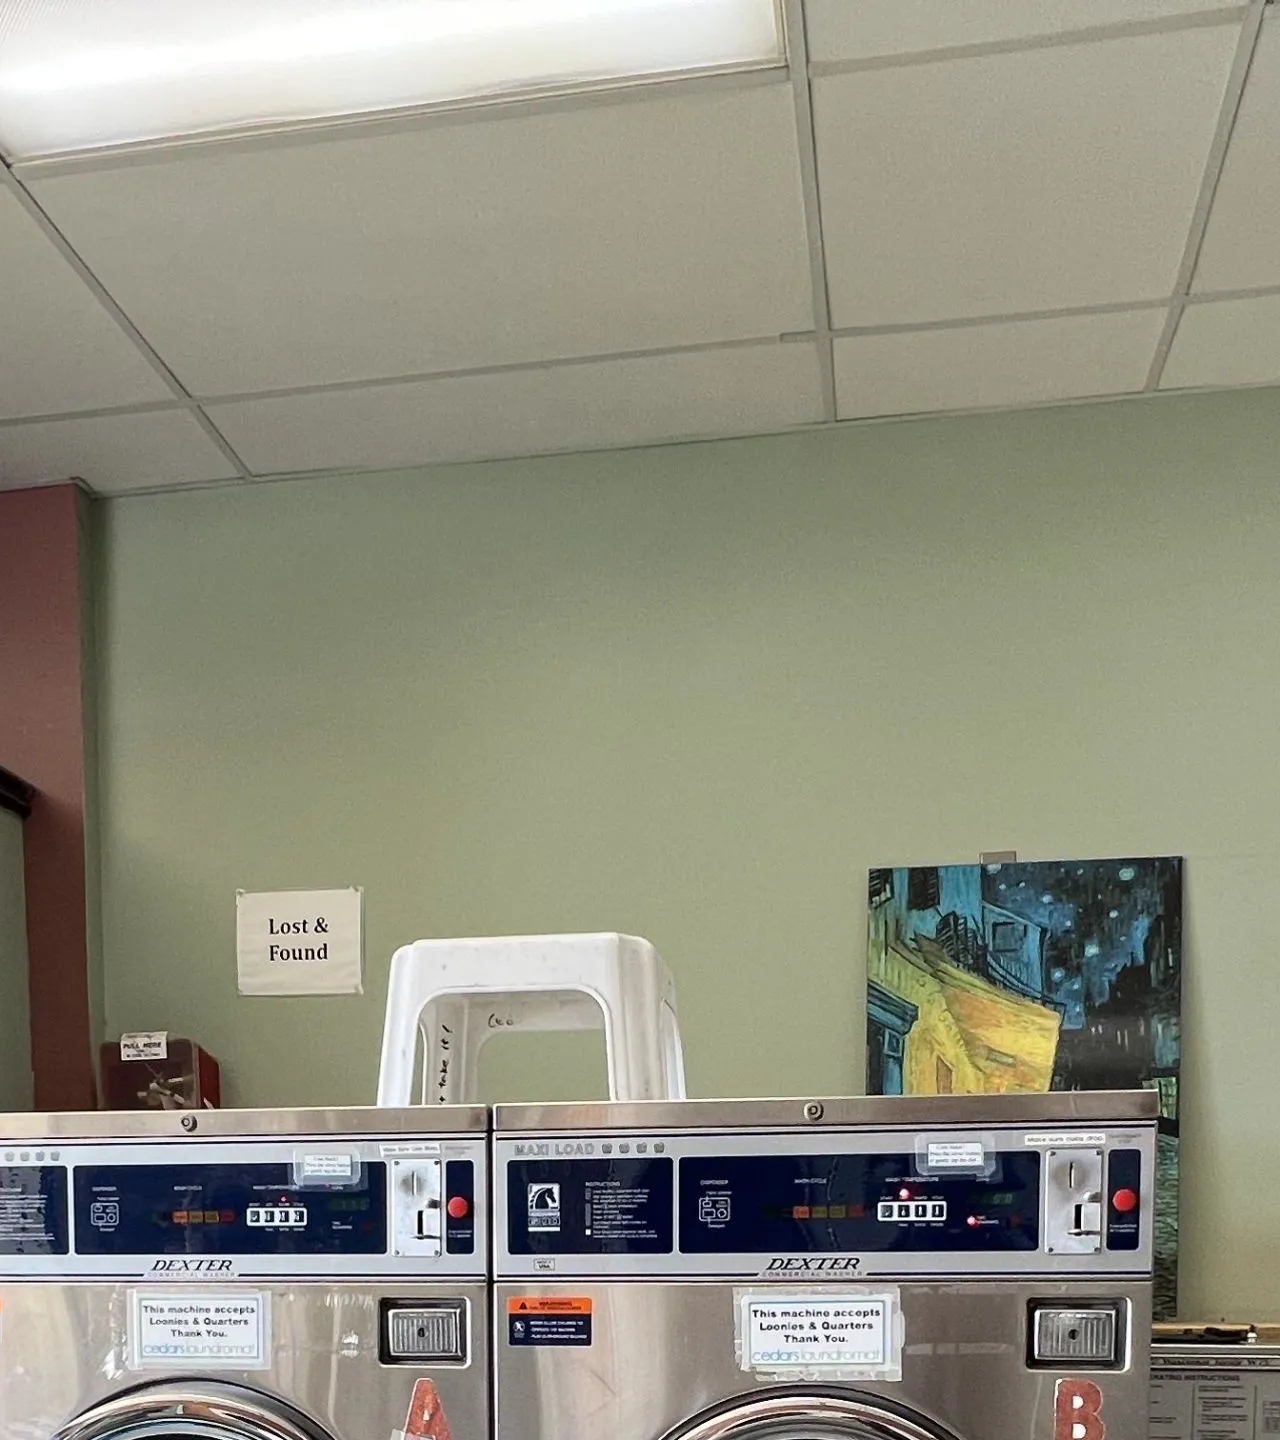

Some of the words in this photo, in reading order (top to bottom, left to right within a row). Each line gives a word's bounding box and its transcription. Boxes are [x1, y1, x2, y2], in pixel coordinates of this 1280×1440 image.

[268, 918, 308, 935] Lost
[313, 917, 329, 934] &
[269, 943, 329, 961] Found
[514, 1144, 549, 1155] MAXI
[555, 1143, 595, 1155] LOAD
[150, 1259, 233, 1271] DEXTER
[765, 1257, 861, 1270] DEXTER
[143, 1305, 165, 1314] This
[168, 1305, 211, 1314] machine
[214, 1305, 256, 1315] accepts
[752, 1309, 777, 1318] This
[781, 1308, 830, 1318] machine
[833, 1308, 881, 1320] accepts
[149, 1317, 189, 1326] Loonies
[192, 1317, 200, 1326] &
[203, 1317, 249, 1326] Quarters
[759, 1321, 805, 1331] Loonies
[808, 1321, 818, 1331] &
[821, 1321, 874, 1331] Quarters
[171, 1328, 203, 1337] Thank
[205, 1329, 228, 1337] You.
[784, 1334, 820, 1343] Thank
[824, 1334, 849, 1343] You.
[752, 1348, 800, 1362] cedars
